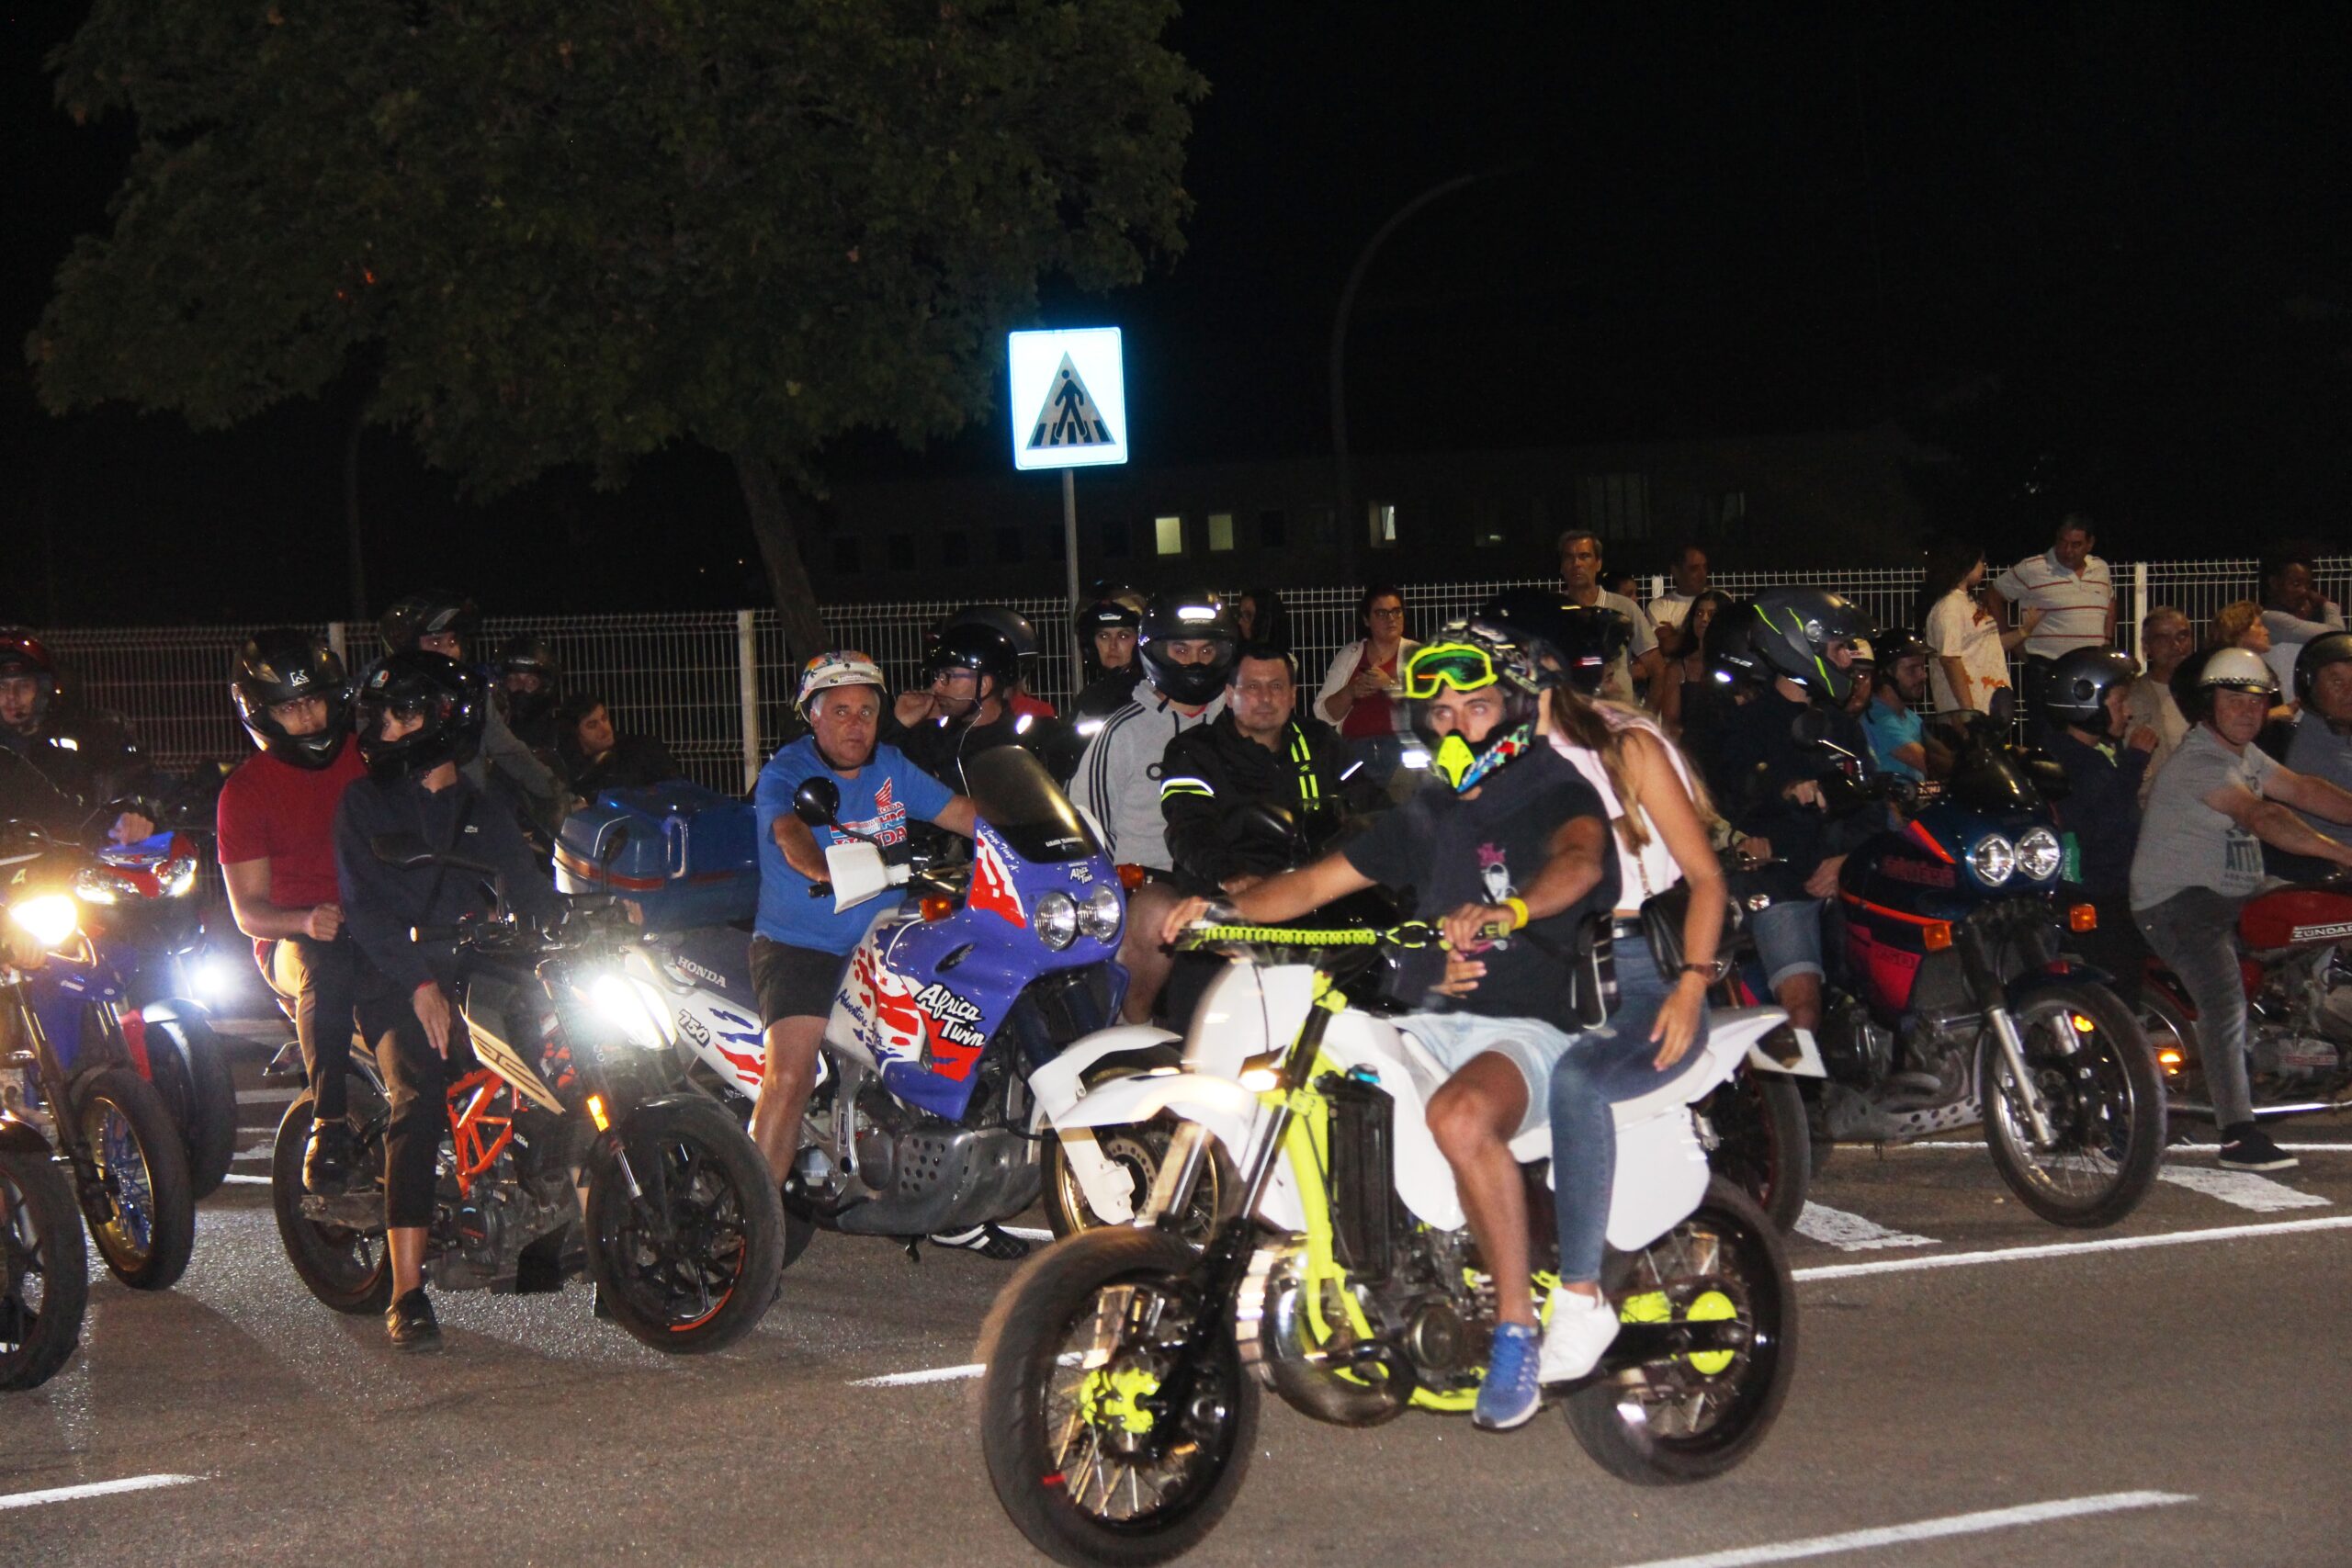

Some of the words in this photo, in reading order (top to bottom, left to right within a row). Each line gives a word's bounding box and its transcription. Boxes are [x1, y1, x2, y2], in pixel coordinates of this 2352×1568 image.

[676, 956, 727, 987] HONDA
[916, 982, 985, 1021] Africa
[678, 1009, 711, 1048] 750
[940, 1013, 986, 1047] Twin
